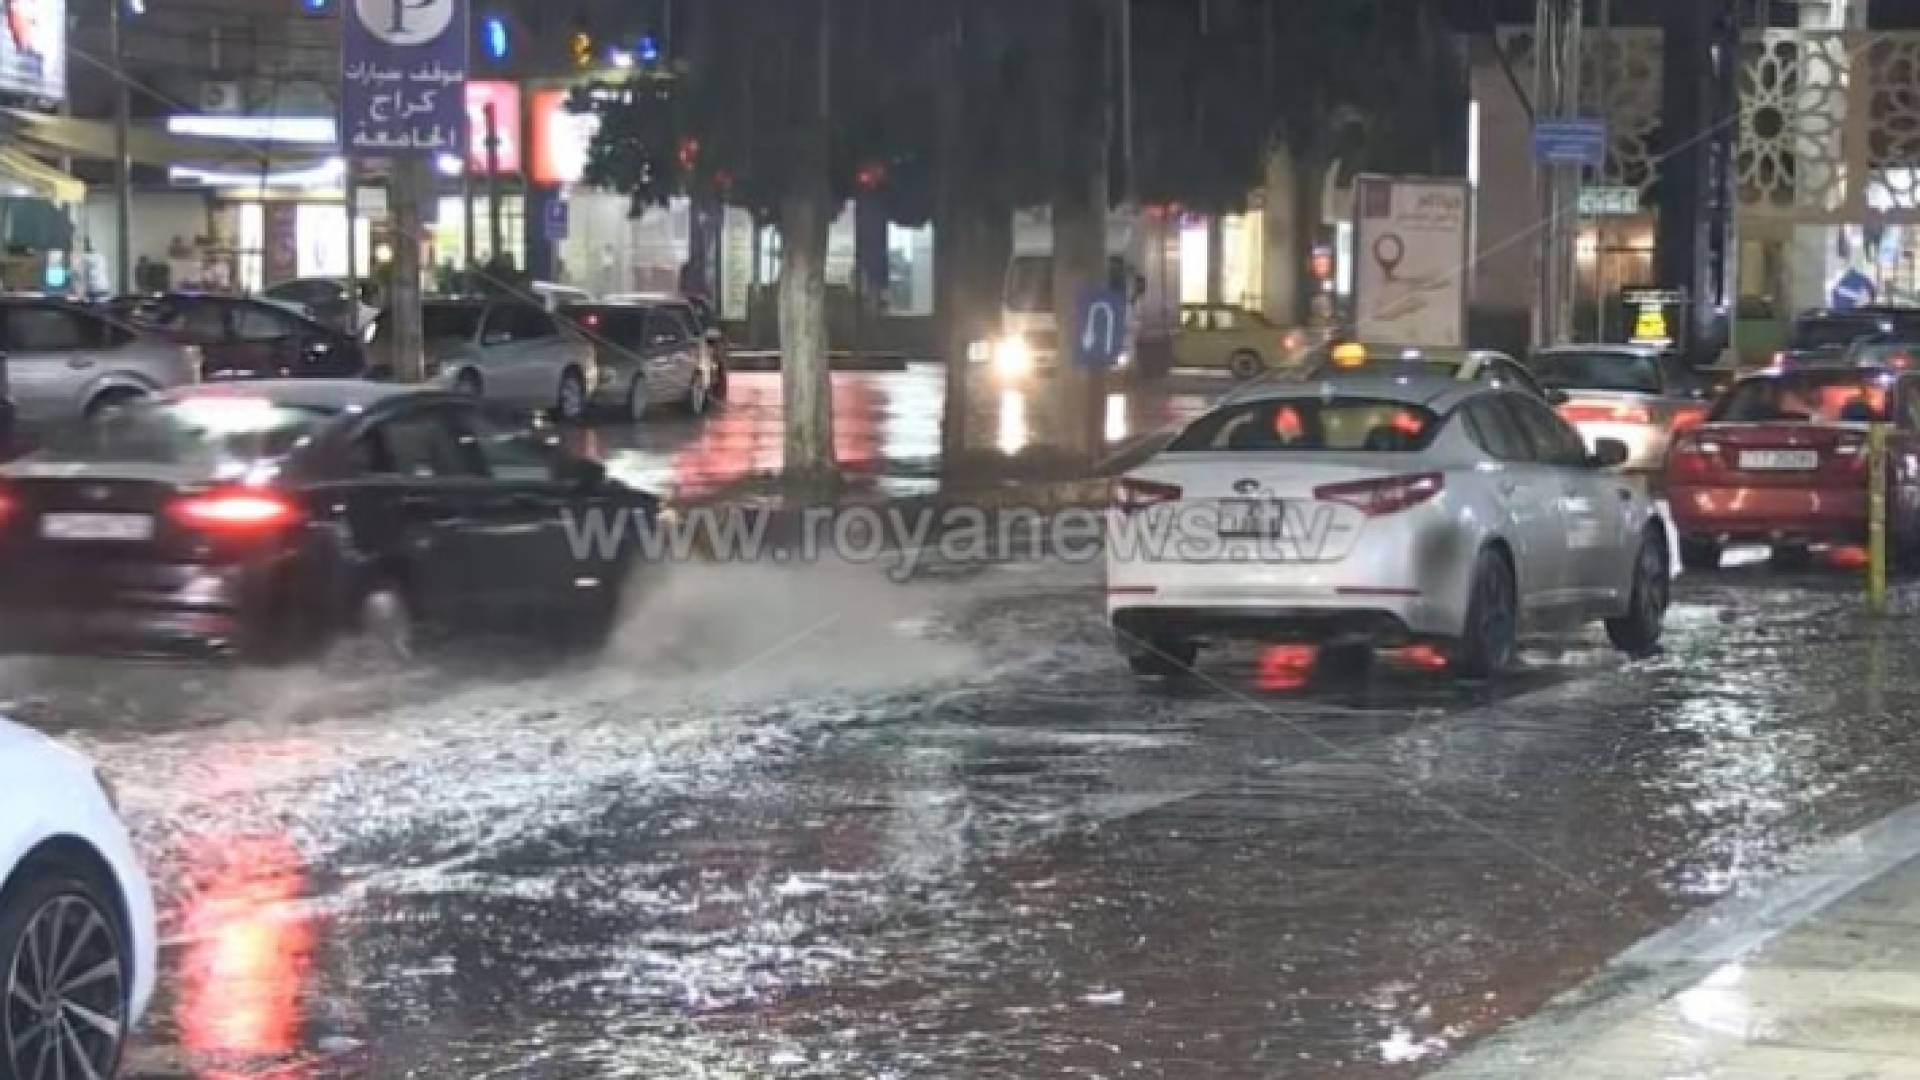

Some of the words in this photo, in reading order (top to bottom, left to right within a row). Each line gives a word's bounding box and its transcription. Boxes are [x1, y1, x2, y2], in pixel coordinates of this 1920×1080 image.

[345, 61, 402, 86] سيارات
[409, 61, 462, 87] موقف
[369, 89, 437, 121] كراج
[352, 121, 455, 148] الجامعة
